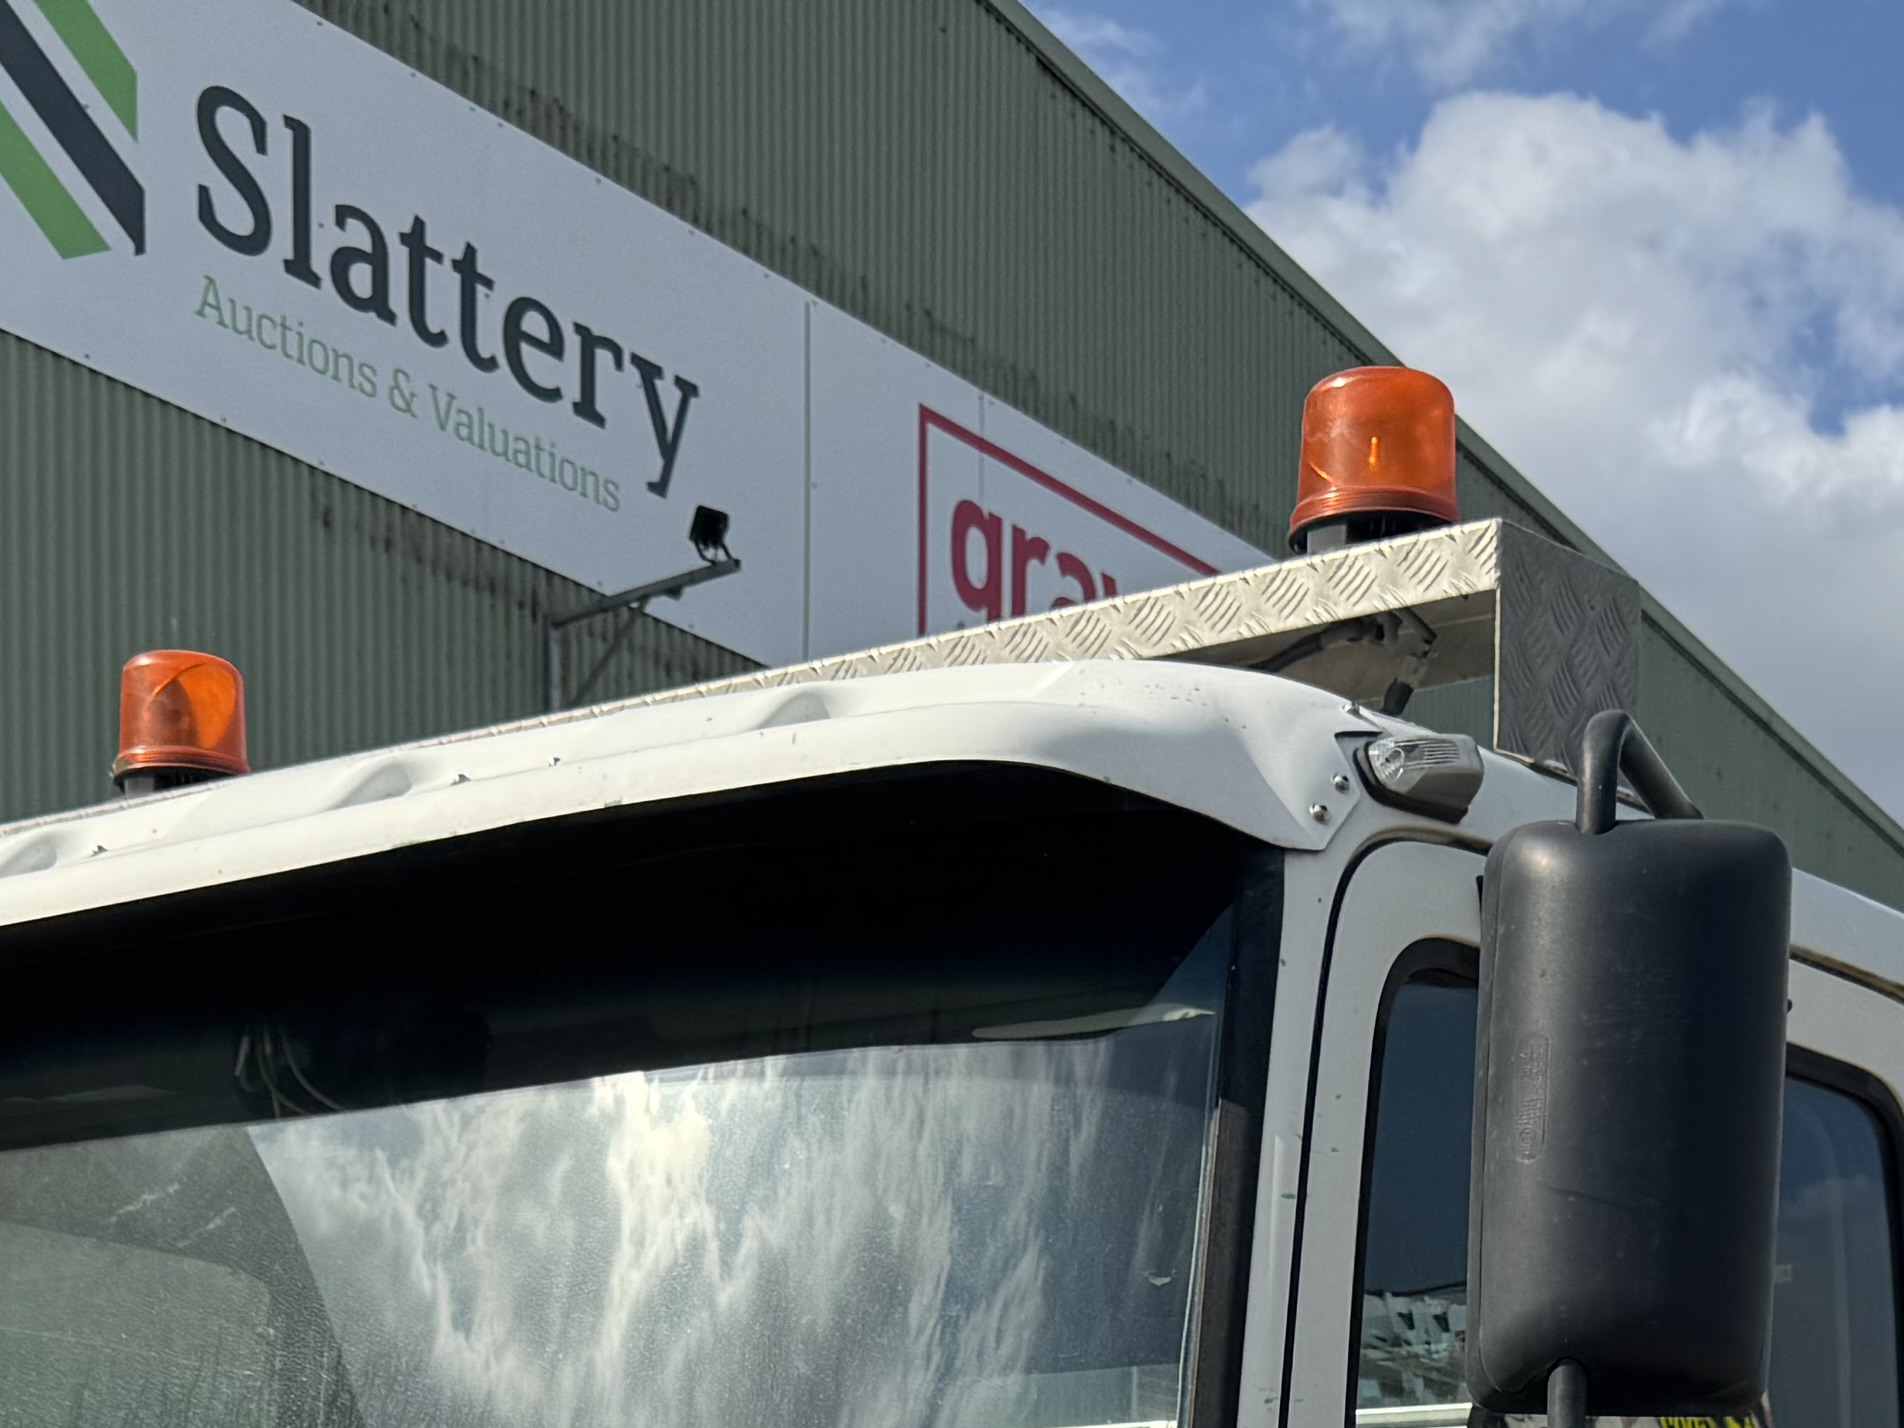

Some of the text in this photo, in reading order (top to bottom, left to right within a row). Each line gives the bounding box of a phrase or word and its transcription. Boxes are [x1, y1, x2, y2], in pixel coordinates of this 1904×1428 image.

[195, 275, 621, 513] Auctions & Valuations
[197, 84, 700, 499] Slattery
[951, 499, 1117, 622] gra
